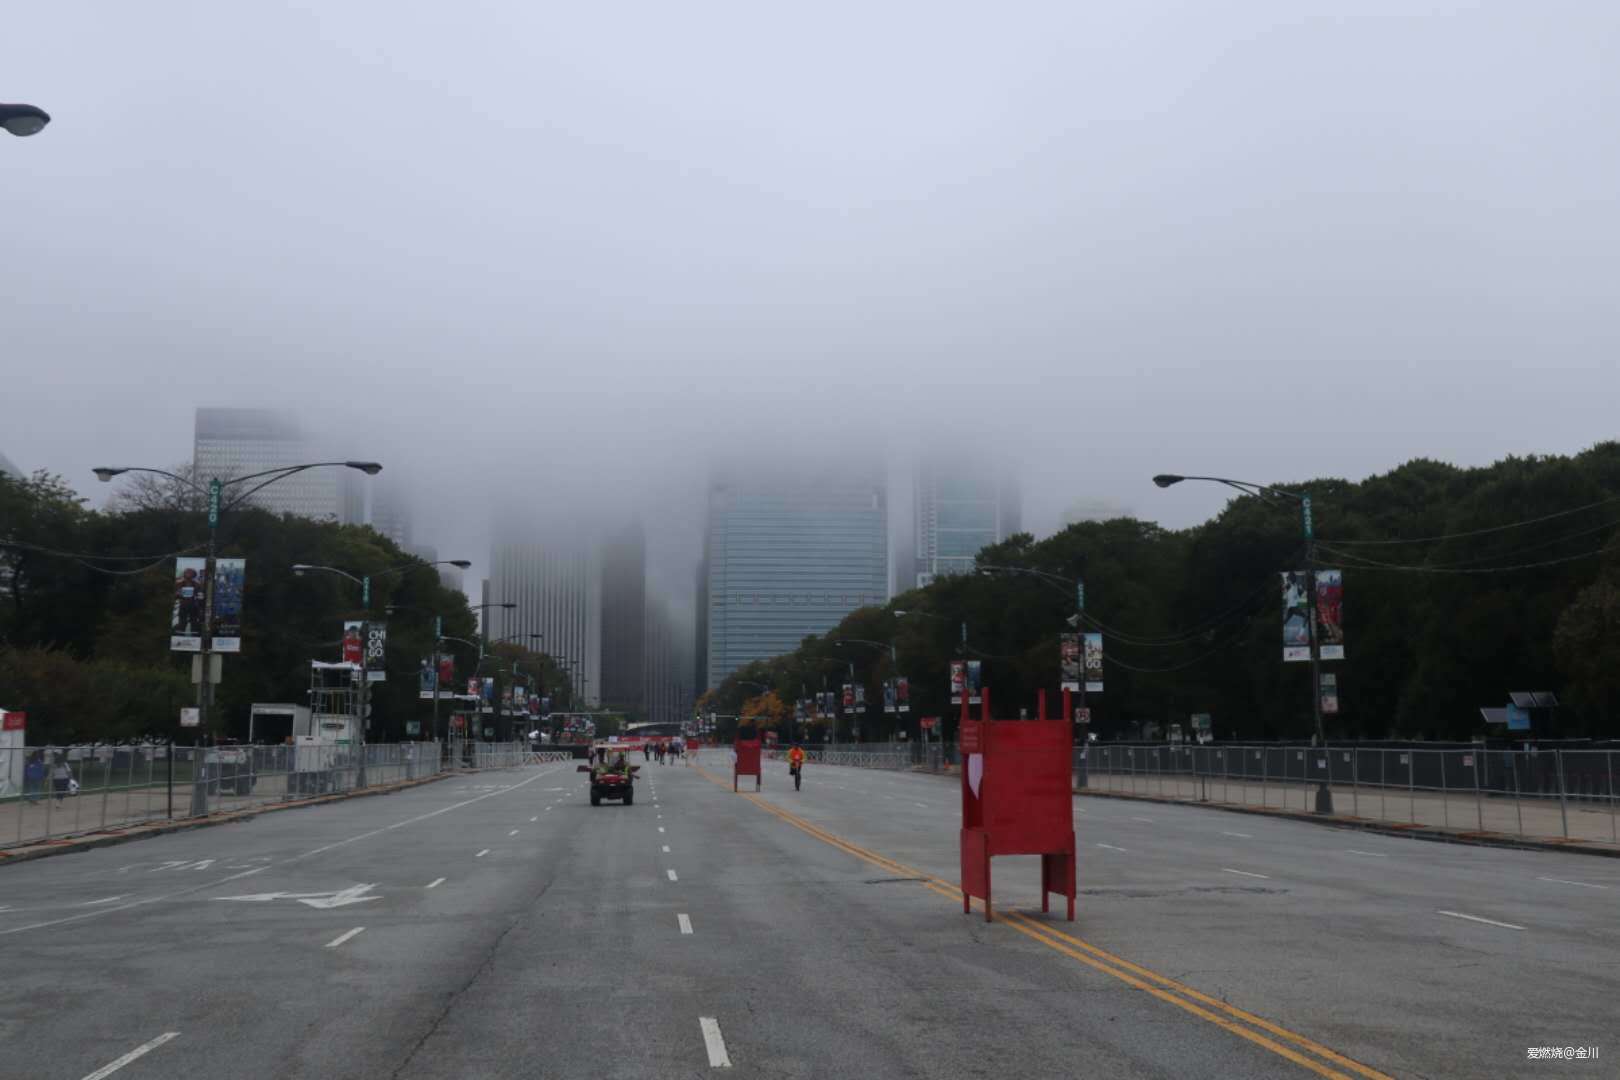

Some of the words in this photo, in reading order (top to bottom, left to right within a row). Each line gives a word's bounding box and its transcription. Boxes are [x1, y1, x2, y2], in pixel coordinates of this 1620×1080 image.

[368, 629, 386, 640] CHI
[367, 639, 383, 649] CA
[368, 648, 383, 657] GO
